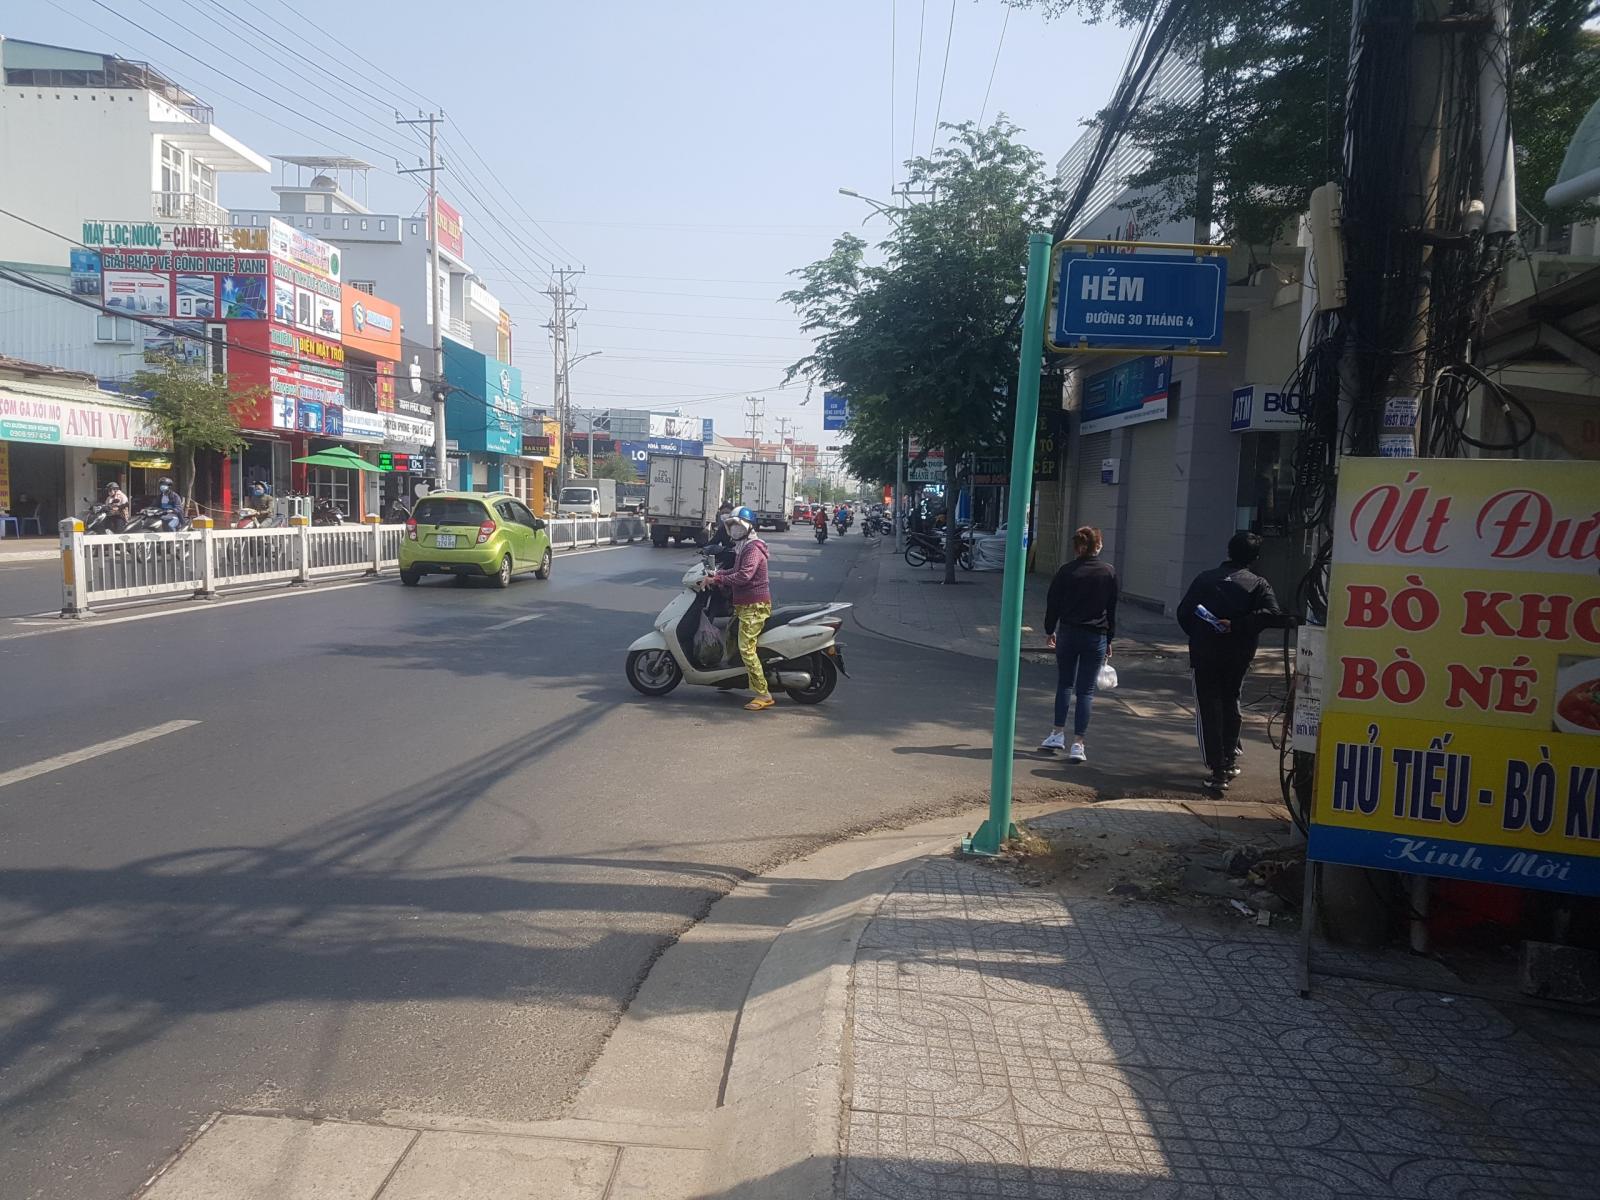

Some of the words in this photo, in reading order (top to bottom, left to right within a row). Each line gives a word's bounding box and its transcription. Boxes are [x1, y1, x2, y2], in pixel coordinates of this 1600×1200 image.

[173, 226, 219, 249] CAMERA
[174, 253, 204, 273] CÔNG
[206, 253, 236, 276] NGHỆ
[238, 258, 267, 274] XANH
[1081, 268, 1145, 302] HẺM
[1086, 310, 1125, 326] ĐƯỜNG
[1128, 314, 1143, 326] 30
[1145, 312, 1184, 327] THÁNG
[1186, 316, 1194, 327] 4
[1234, 394, 1251, 423] ATM
[1264, 391, 1301, 414] BID
[66, 408, 104, 438] ANH
[108, 413, 131, 441] VY
[632, 450, 648, 461] LO
[1351, 472, 1452, 554] Út
[1476, 489, 1600, 561] Đư
[1344, 575, 1440, 632] BÒ
[1338, 648, 1426, 704] BÒ
[1445, 656, 1538, 714] NÉ
[1332, 723, 1383, 815] HỦ
[1393, 732, 1472, 825] TIẾU
[1479, 789, 1493, 805] -
[1502, 745, 1557, 835] BÒ
[1493, 851, 1572, 882] Mời
